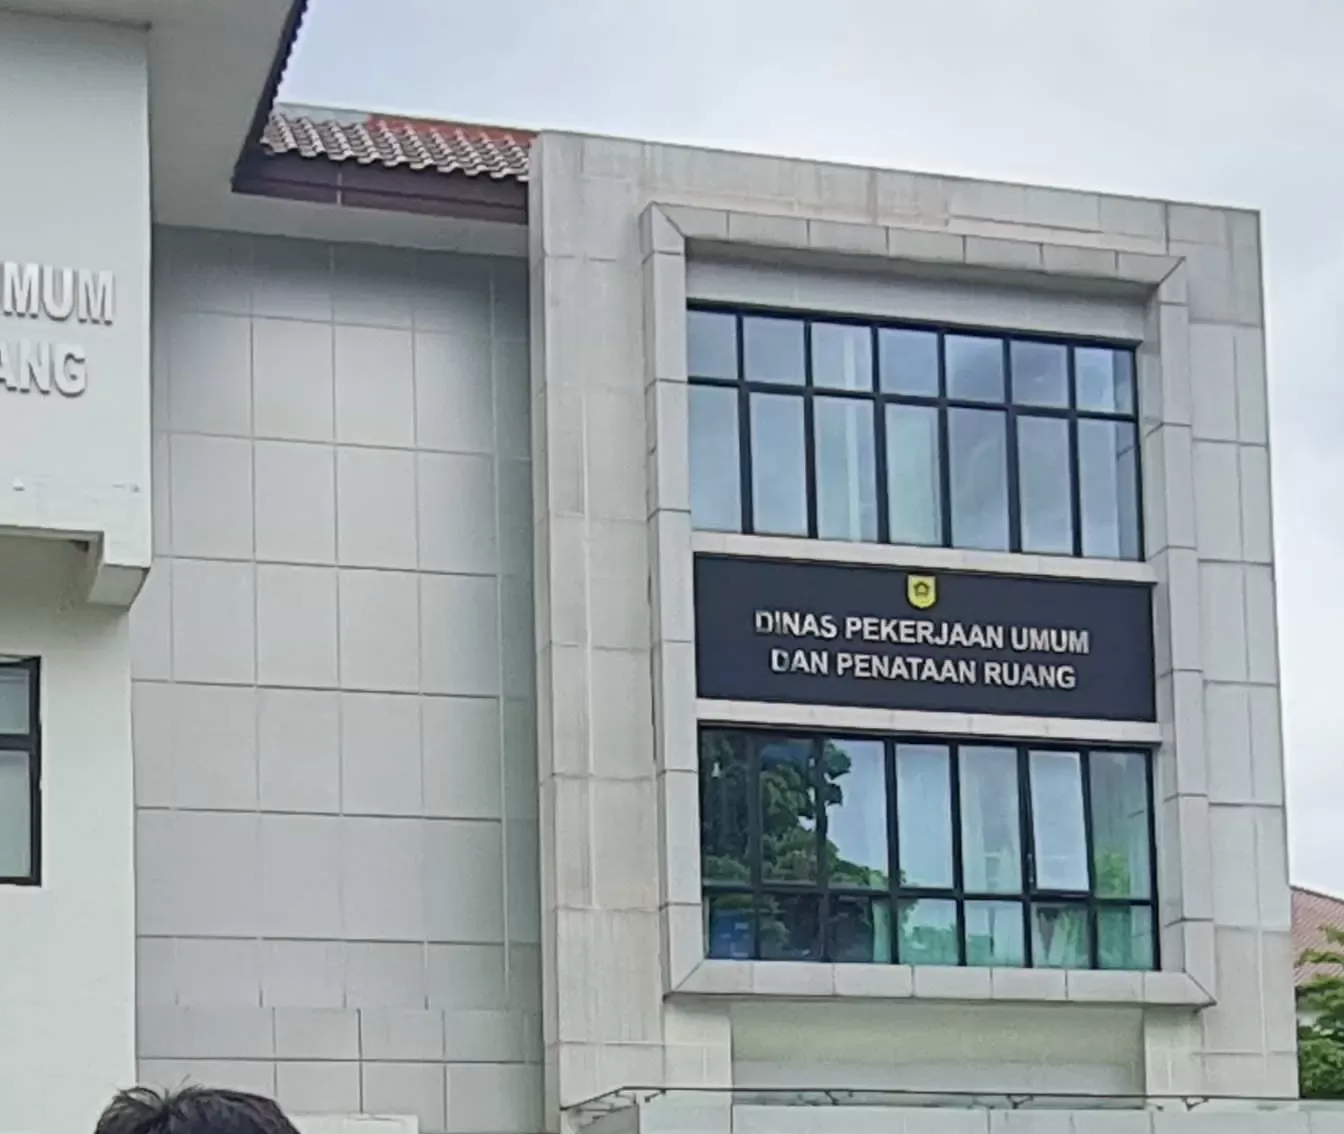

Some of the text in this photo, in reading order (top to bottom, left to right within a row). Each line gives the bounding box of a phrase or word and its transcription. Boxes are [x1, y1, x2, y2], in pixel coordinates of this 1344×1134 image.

[755, 610, 1089, 654] DINAS PEKERJAAN UMUM
[771, 648, 1076, 688] DAN PENATAAN RUANG
